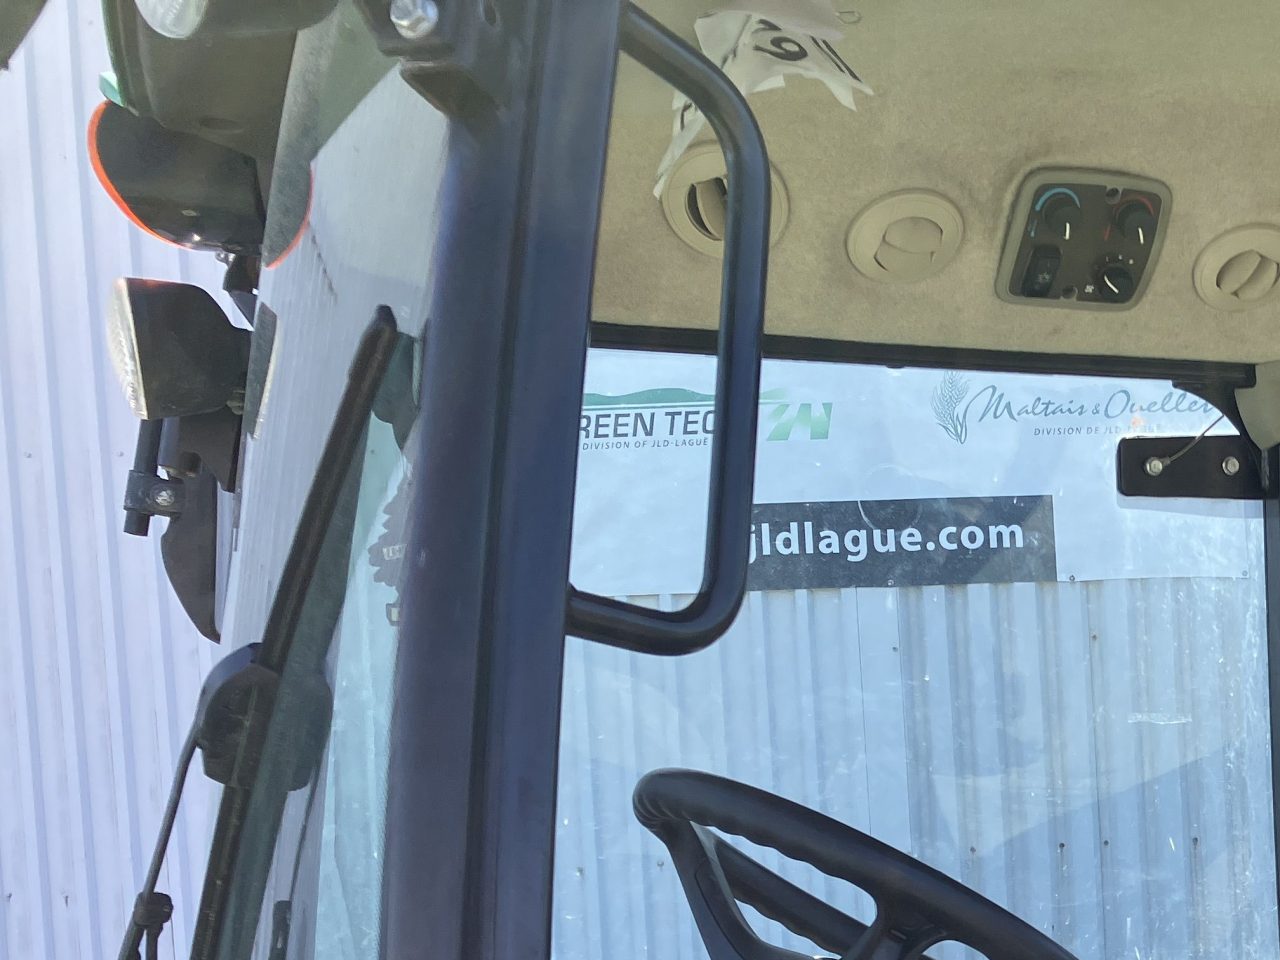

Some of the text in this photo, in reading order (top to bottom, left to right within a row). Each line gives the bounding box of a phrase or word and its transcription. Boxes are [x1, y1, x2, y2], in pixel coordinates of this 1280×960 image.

[966, 384, 1085, 423] Maltais
[1091, 401, 1101, 416] &
[579, 409, 715, 439] REEN TEC
[1033, 427, 1081, 437] DIVISION
[1086, 427, 1099, 435] DE
[582, 441, 630, 451] DIVISION
[634, 440, 647, 449] OF
[749, 521, 1024, 564] jldlague.com
